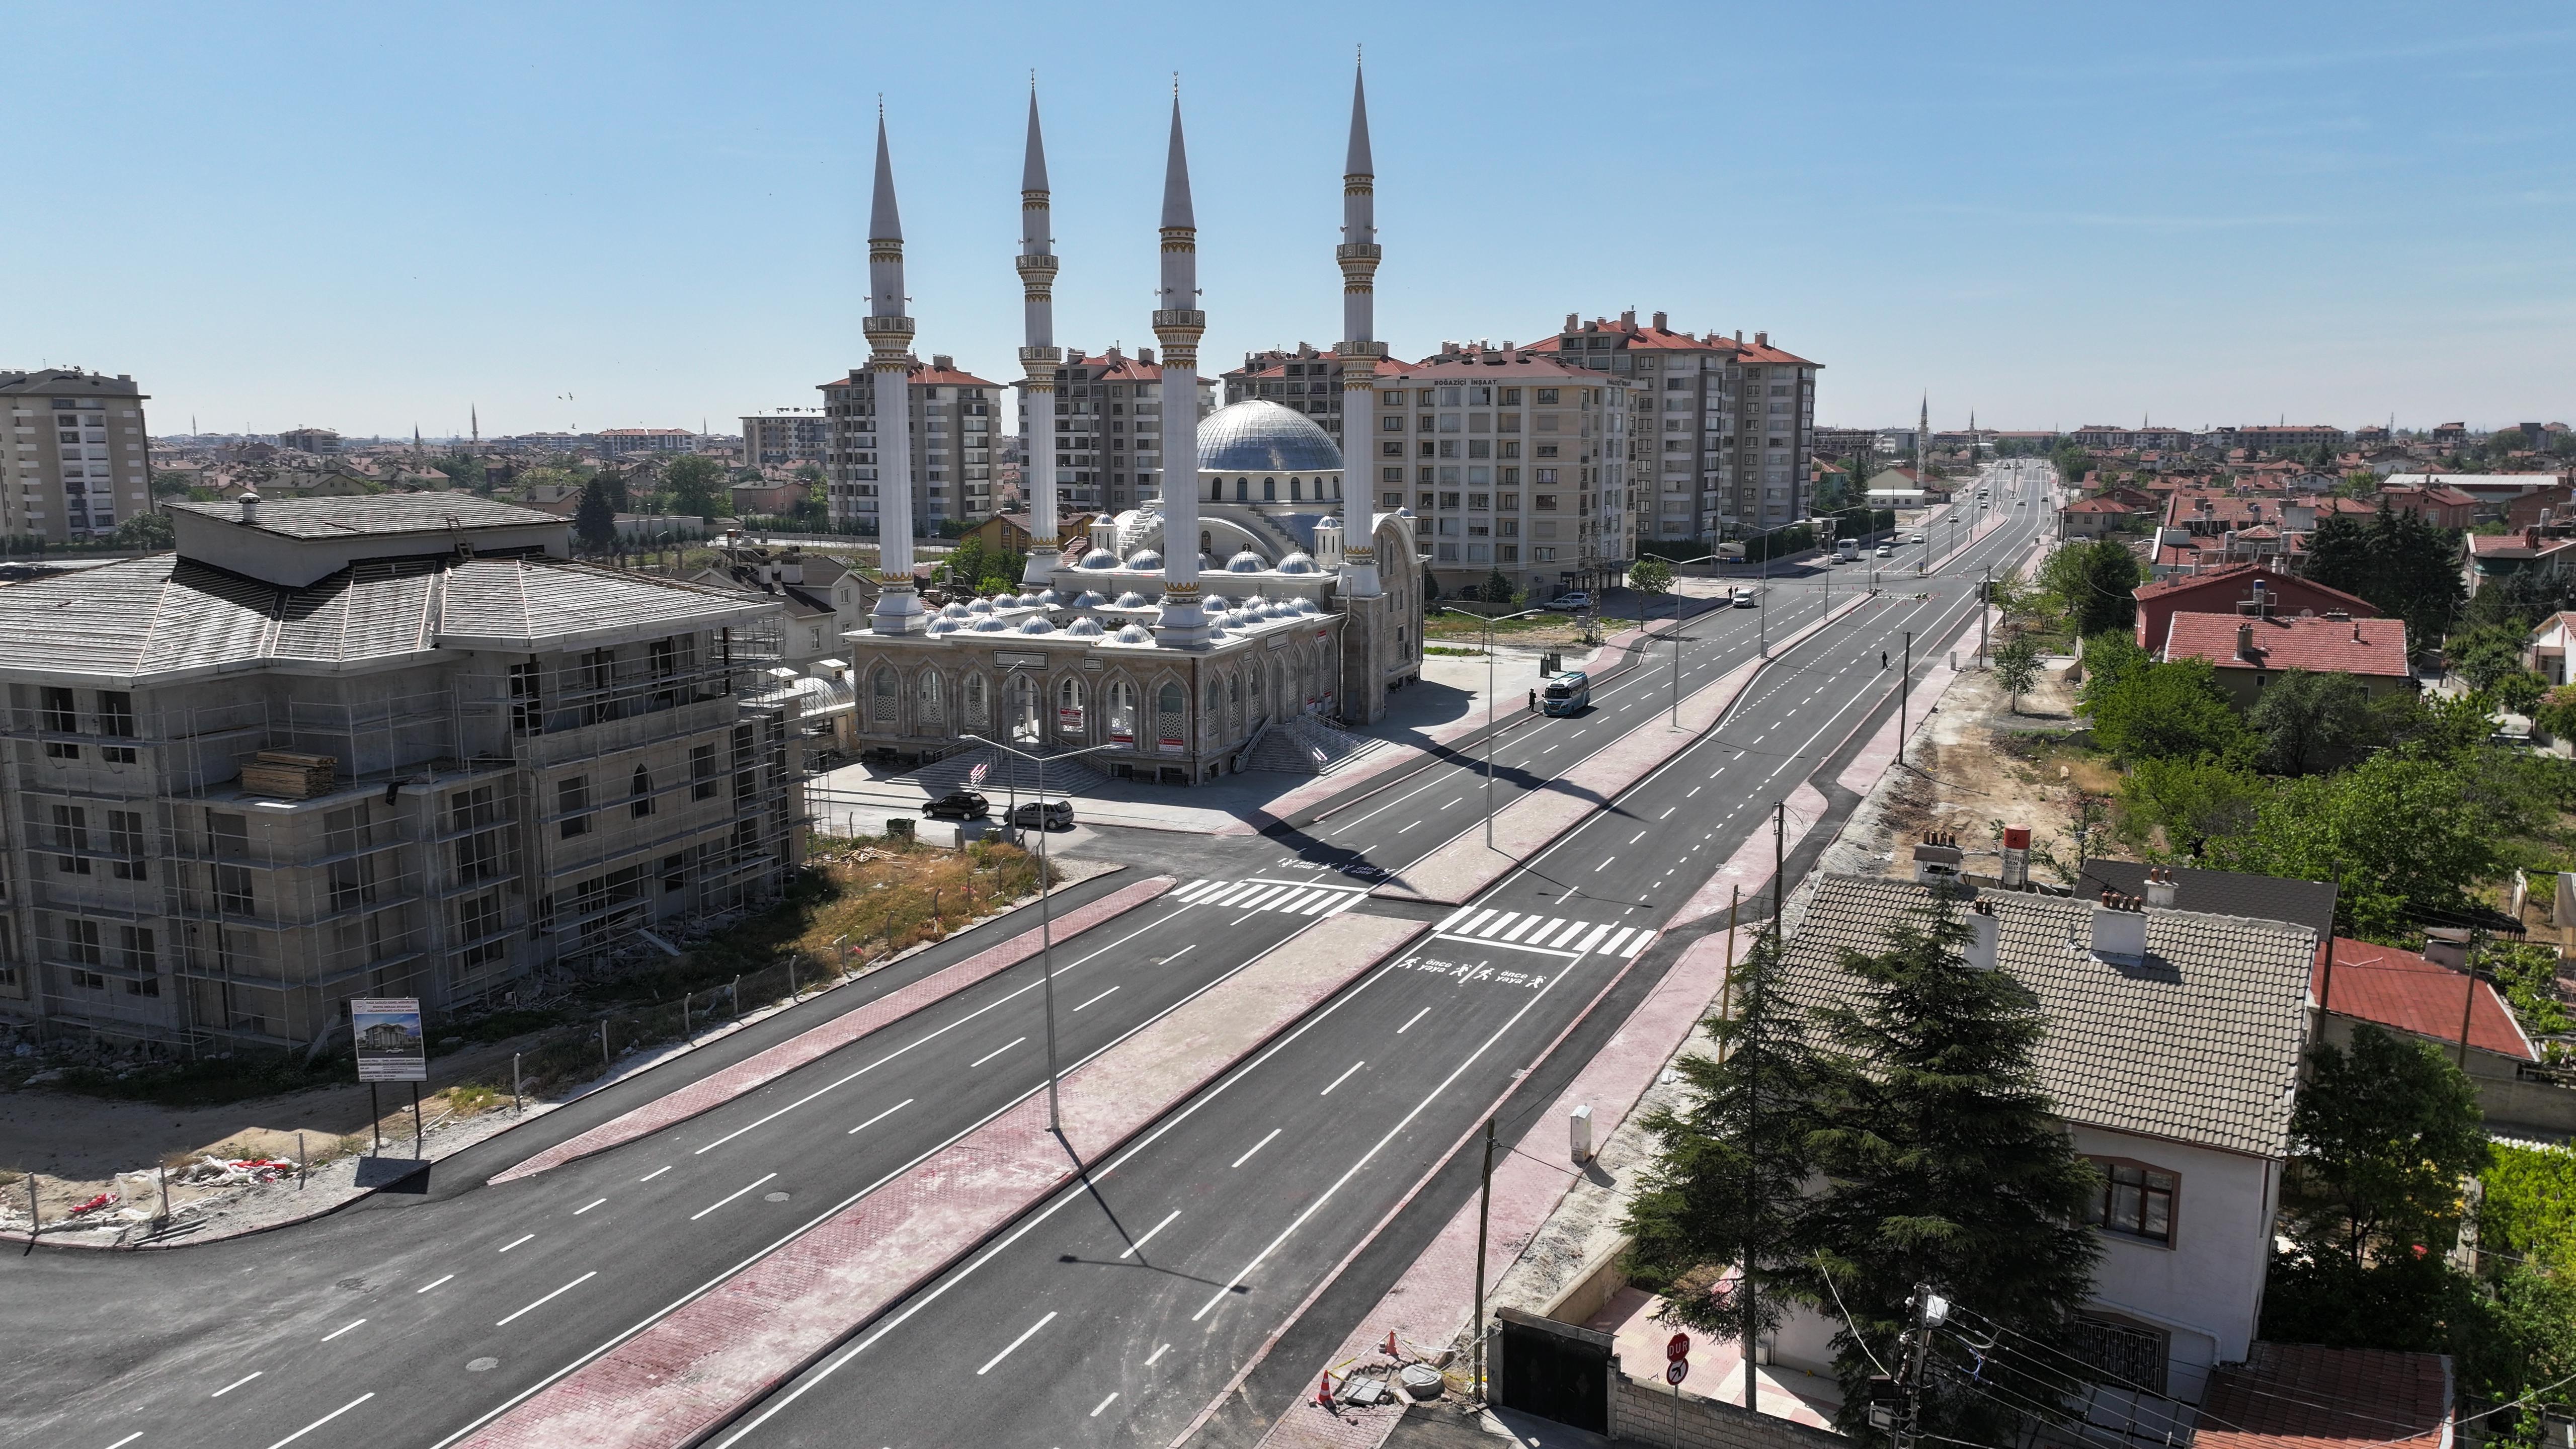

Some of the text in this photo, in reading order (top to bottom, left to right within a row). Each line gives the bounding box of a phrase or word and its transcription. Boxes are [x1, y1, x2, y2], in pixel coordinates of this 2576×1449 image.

[1426, 959, 1452, 968] önce
[1417, 964, 1445, 973] yaya
[1501, 970, 1528, 979] önce
[1669, 1341, 1687, 1356] DUR
